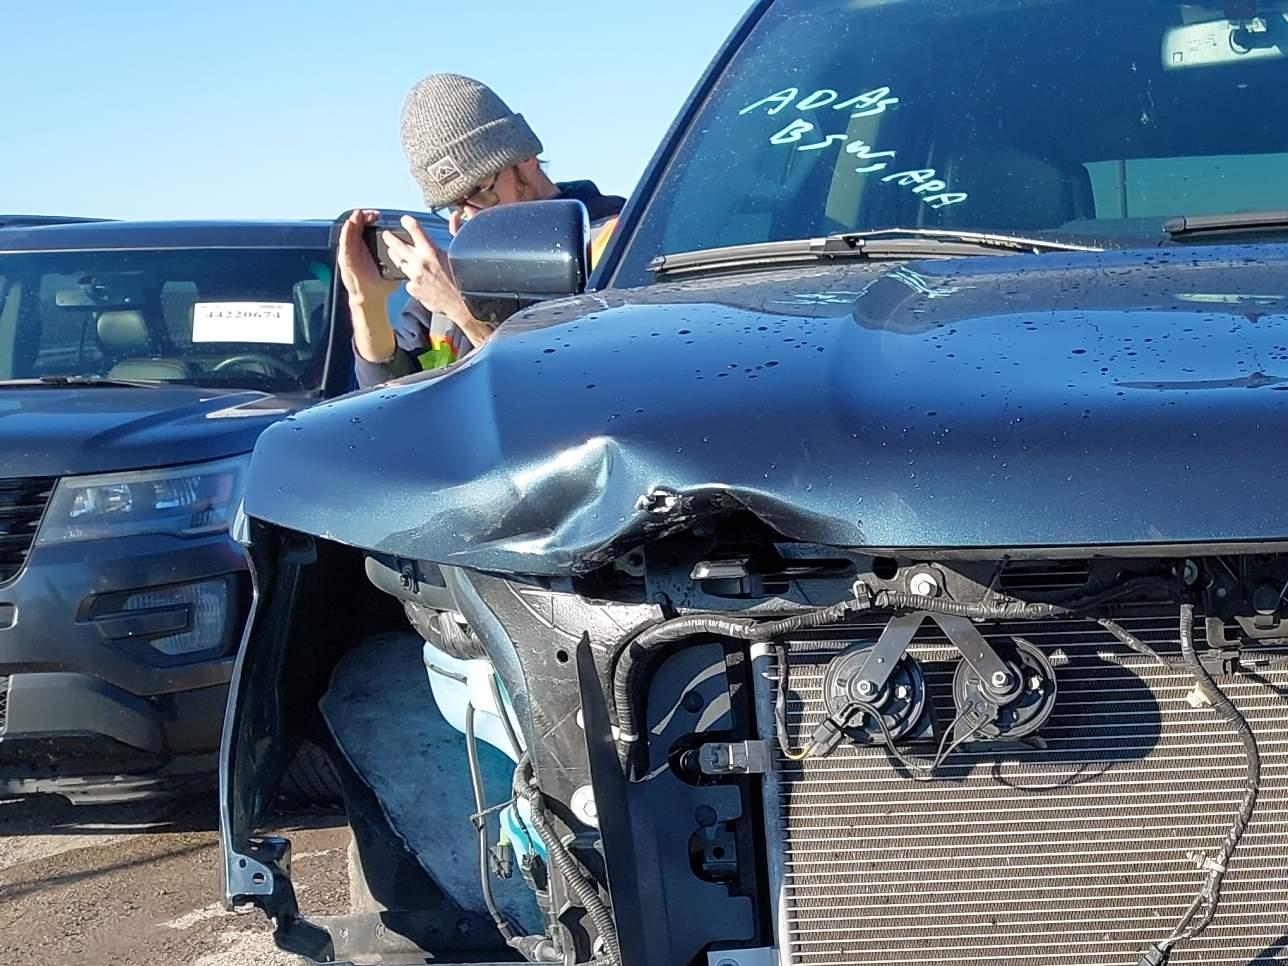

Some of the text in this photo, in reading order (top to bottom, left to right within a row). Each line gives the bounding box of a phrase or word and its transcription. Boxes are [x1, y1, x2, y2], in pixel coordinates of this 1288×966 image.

[739, 86, 899, 118] ADAS
[880, 168, 968, 209] APA
[204, 310, 281, 319] 44220674
